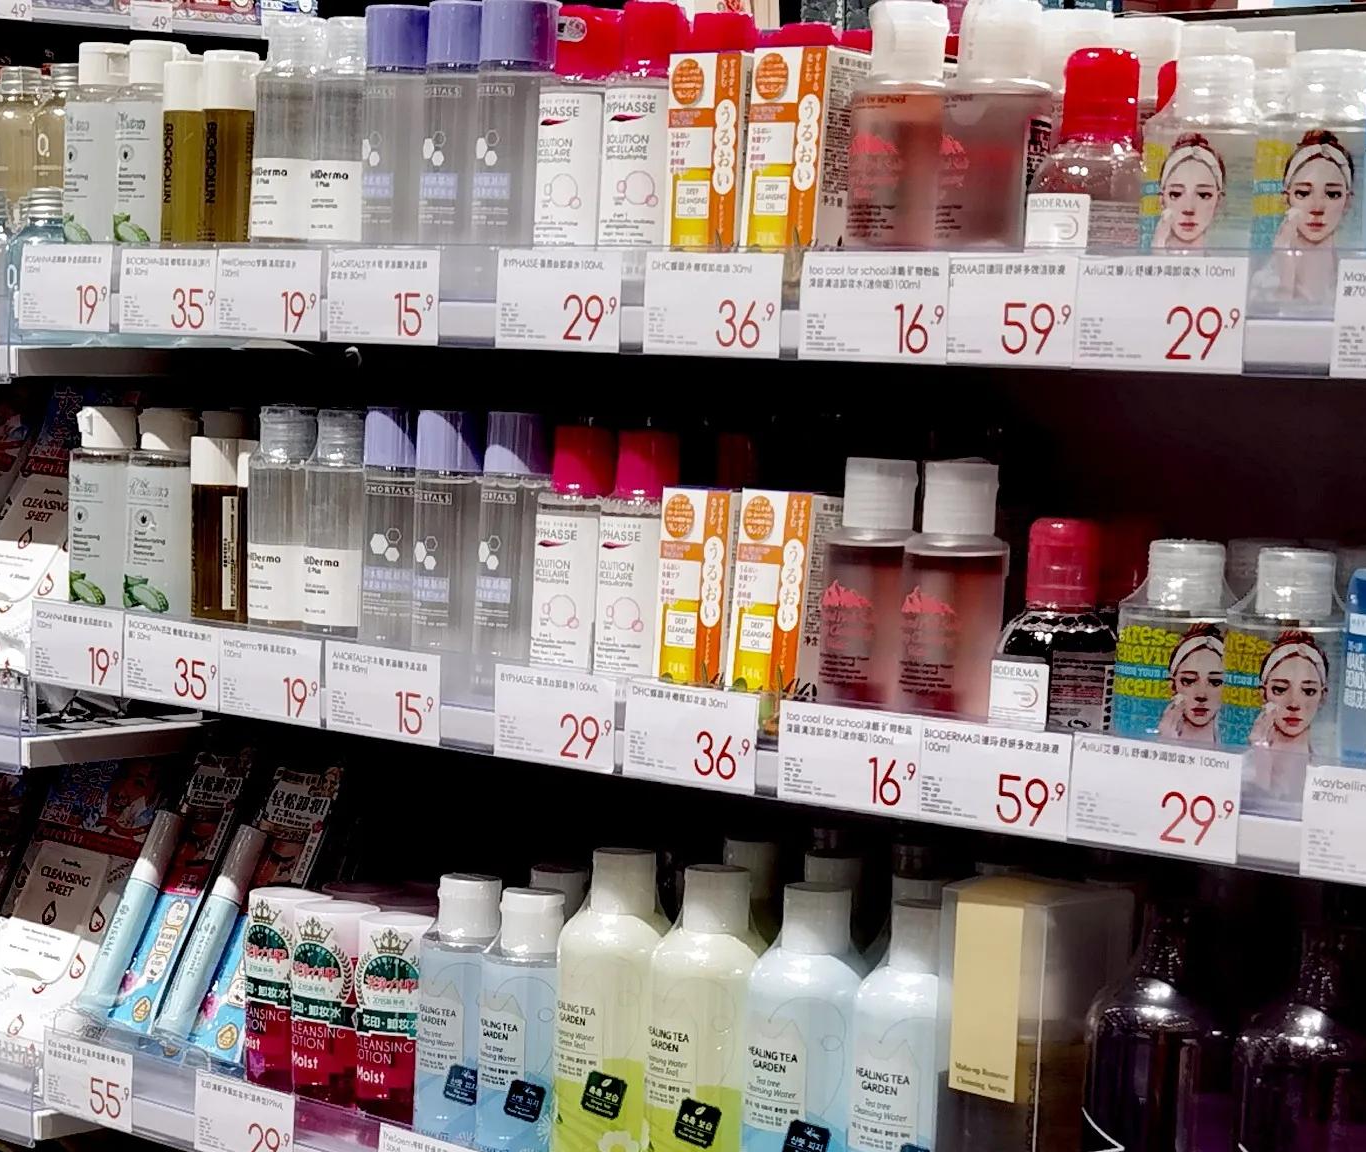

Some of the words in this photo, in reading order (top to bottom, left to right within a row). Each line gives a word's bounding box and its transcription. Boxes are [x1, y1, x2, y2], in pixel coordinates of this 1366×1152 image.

[717, 102, 732, 192] うるおい
[798, 99, 815, 187] うるおい
[705, 544, 721, 623] うるおい
[783, 543, 800, 625] うるおい
[580, 1005, 596, 1017] TEA
[503, 1022, 518, 1034] TEA
[674, 1032, 689, 1043] TEA
[651, 1039, 679, 1053] GARDEN
[752, 1059, 786, 1074] GARDEN
[357, 1066, 385, 1085] Moist
[855, 1067, 889, 1083] HEALING
[891, 1073, 910, 1085] TEA
[861, 1081, 898, 1096] GARDEN
